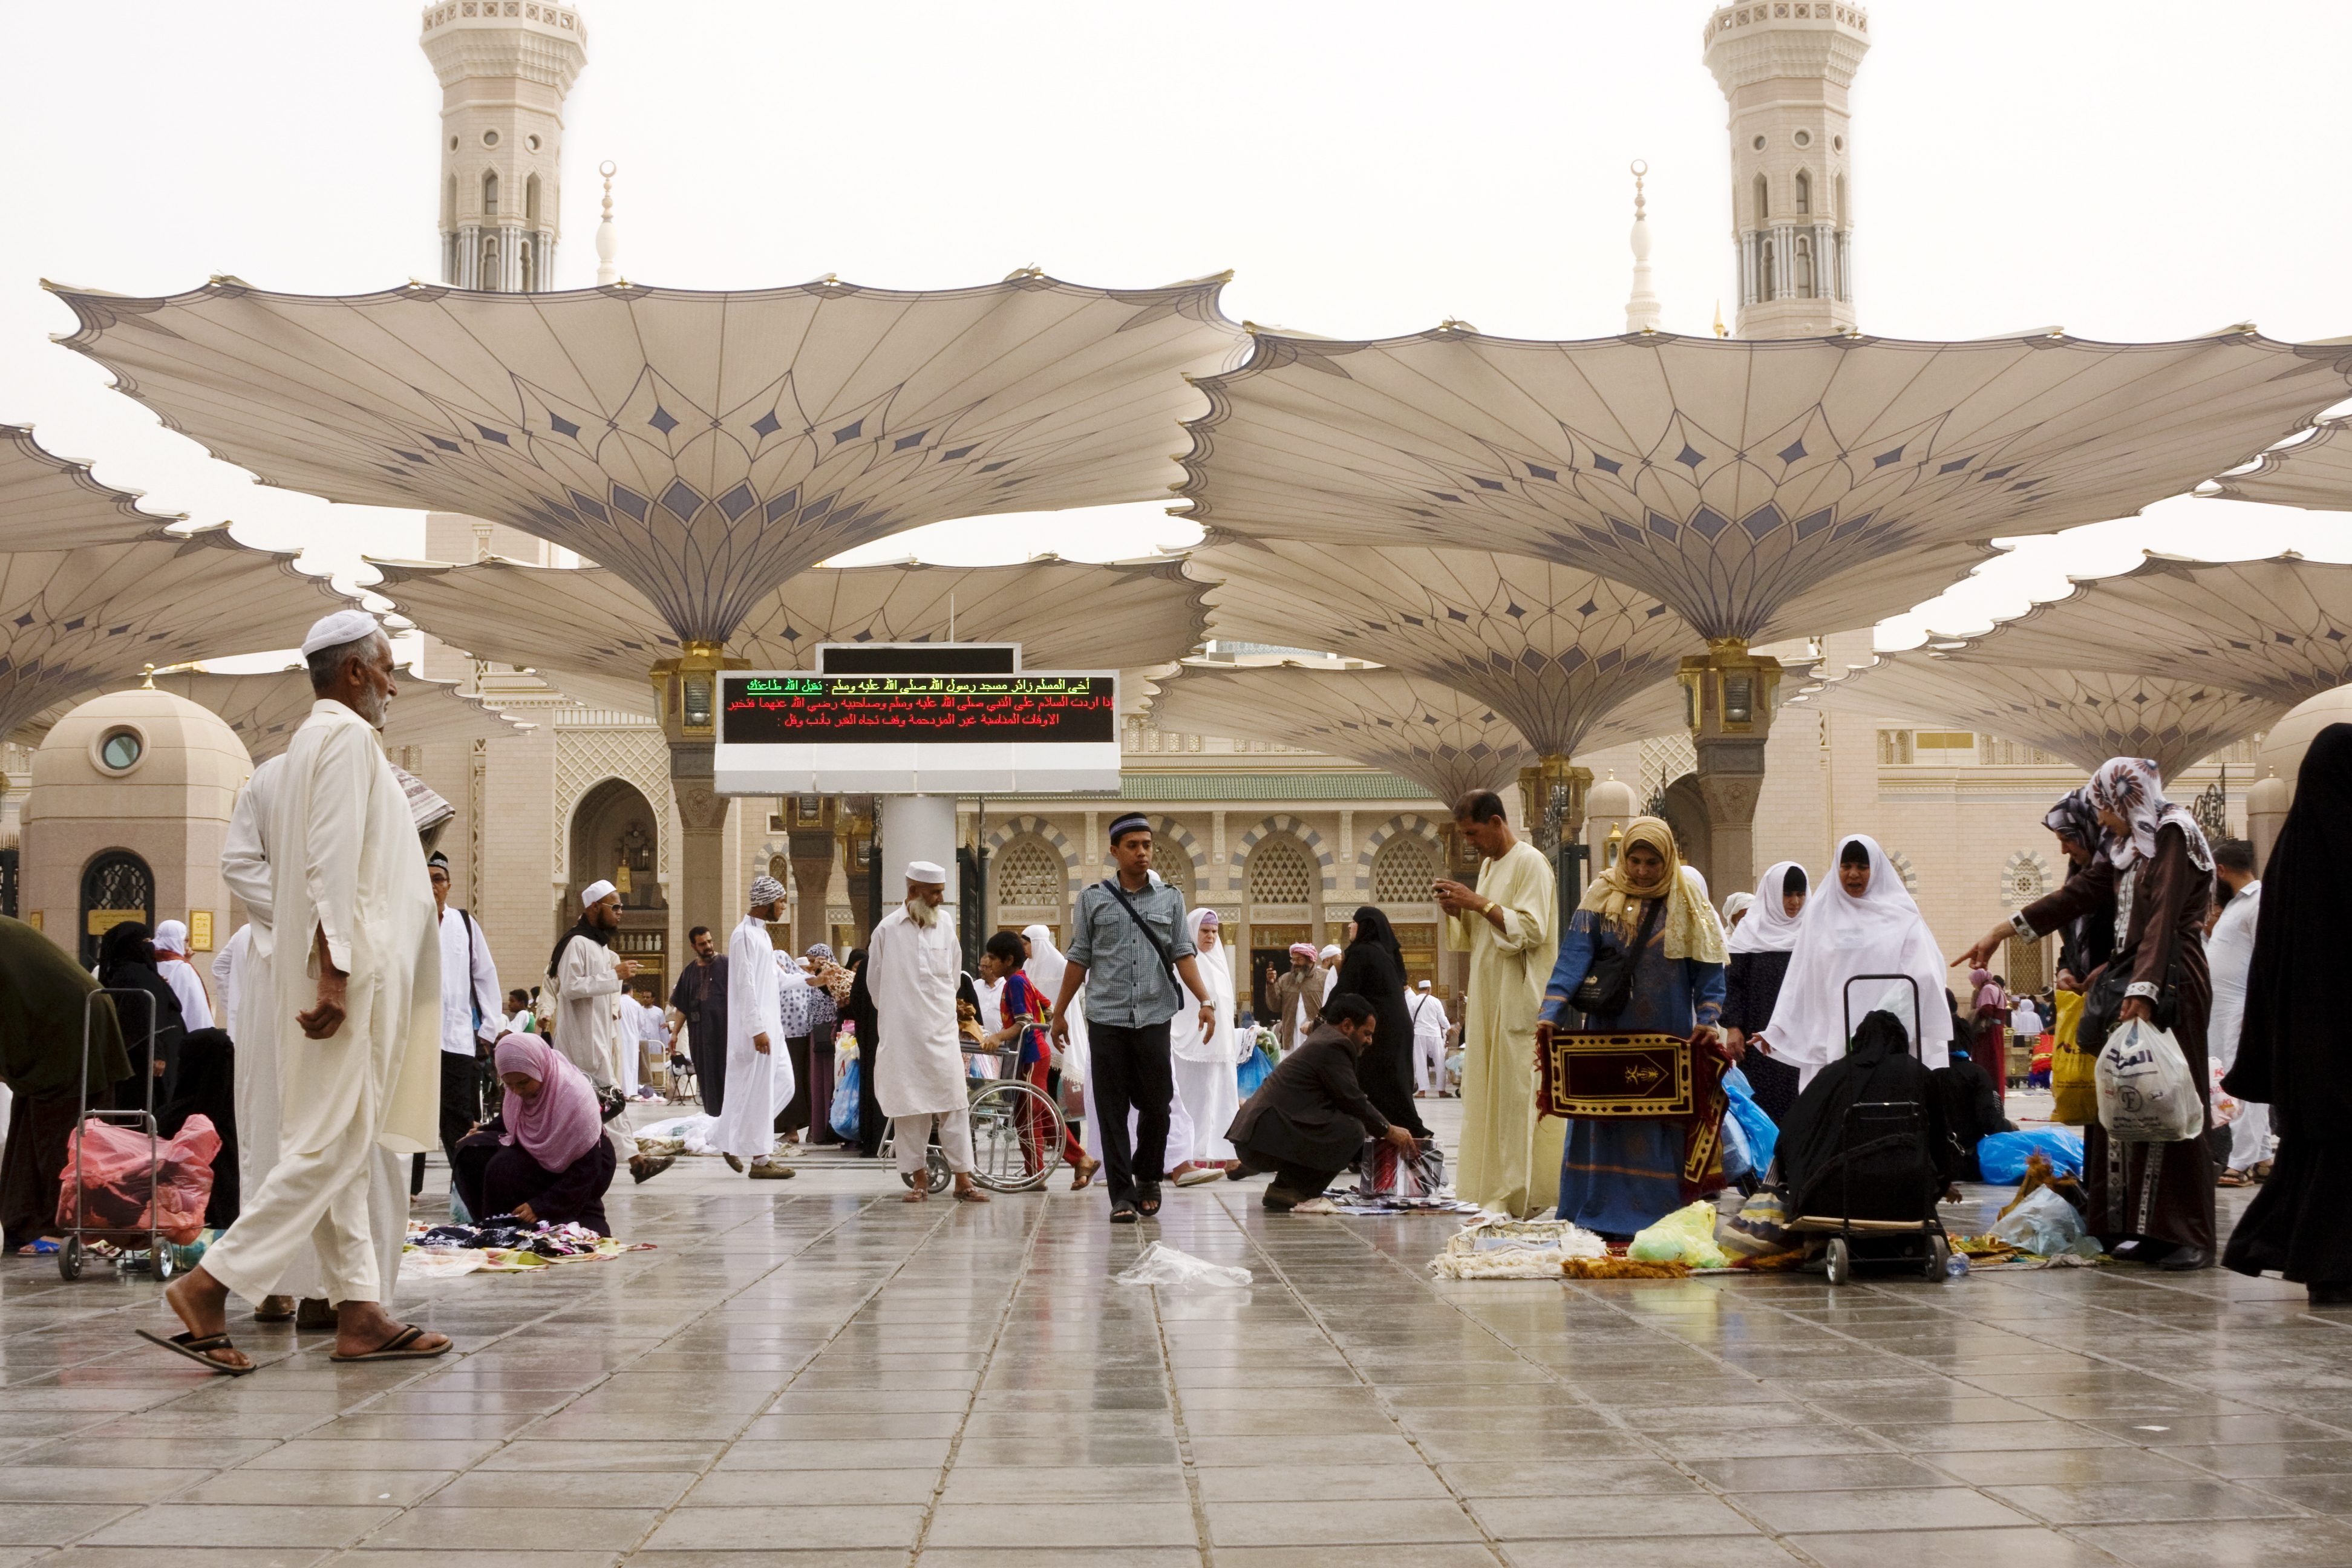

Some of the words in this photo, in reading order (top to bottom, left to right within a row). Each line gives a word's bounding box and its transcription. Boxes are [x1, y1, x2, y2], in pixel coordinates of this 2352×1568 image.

[747, 679, 782, 690] طاعتك
[785, 678, 798, 690] الله
[802, 679, 822, 692] تقبل
[832, 679, 855, 693] وسلم
[858, 679, 880, 692] عليه
[884, 678, 897, 690] الله
[929, 678, 942, 690] الله
[946, 679, 976, 692] رسول
[980, 683, 1007, 691] مسجد
[1011, 679, 1033, 692] زائر
[1036, 679, 1065, 693] المسلم
[759, 697, 787, 710] عنهما
[791, 696, 805, 708] الله
[840, 697, 887, 710] وصاحبيه
[888, 696, 913, 711] وسلم
[915, 696, 937, 710] عليه
[941, 696, 955, 708] الله
[1037, 696, 1068, 711] السلام
[858, 714, 880, 726] تجاه
[958, 716, 977, 727] غير
